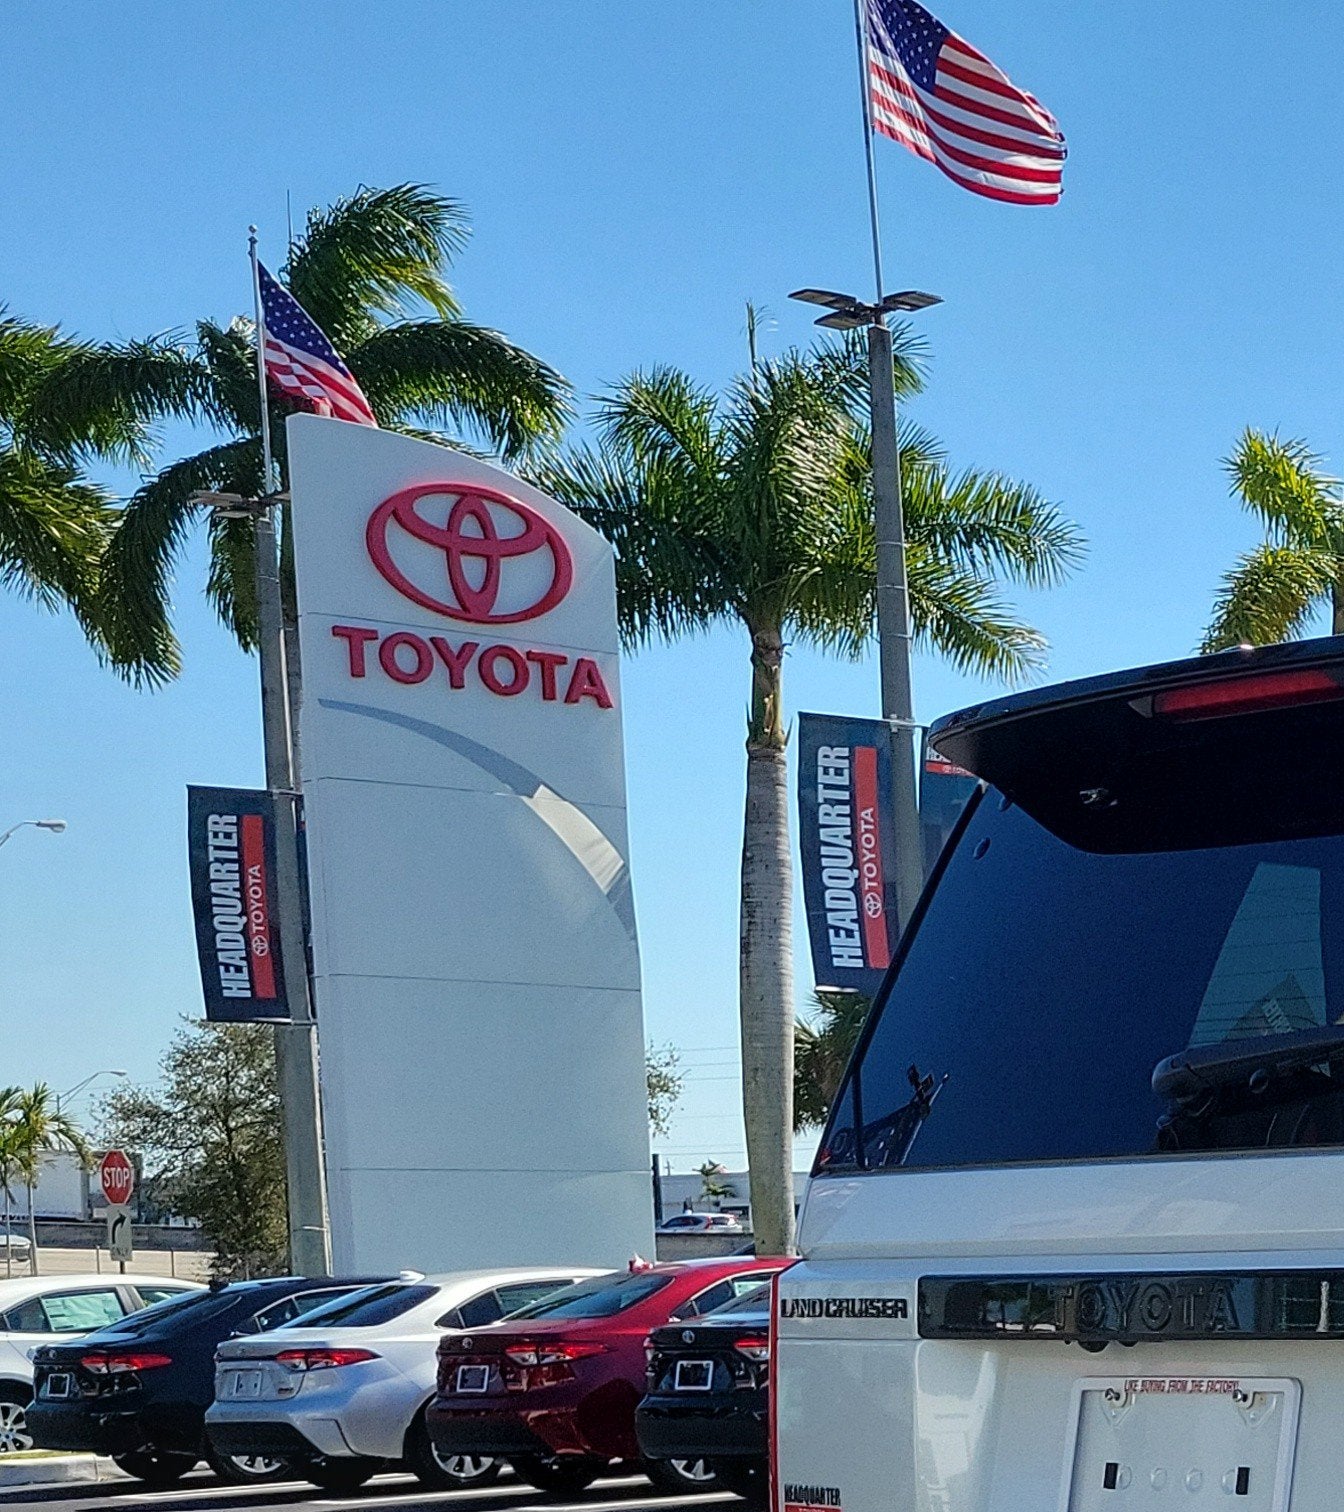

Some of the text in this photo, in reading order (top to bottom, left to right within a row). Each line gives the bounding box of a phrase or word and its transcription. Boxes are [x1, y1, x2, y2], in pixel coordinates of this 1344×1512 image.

[332, 625, 614, 709] TOYOTA
[818, 745, 864, 968] HEADQUARTER
[860, 807, 879, 891] TOYOTA
[207, 813, 251, 998] HEADQUARTER
[248, 864, 266, 934] TOYOTA
[103, 1166, 130, 1188] STOP
[1048, 1277, 1241, 1332] TOYOTA
